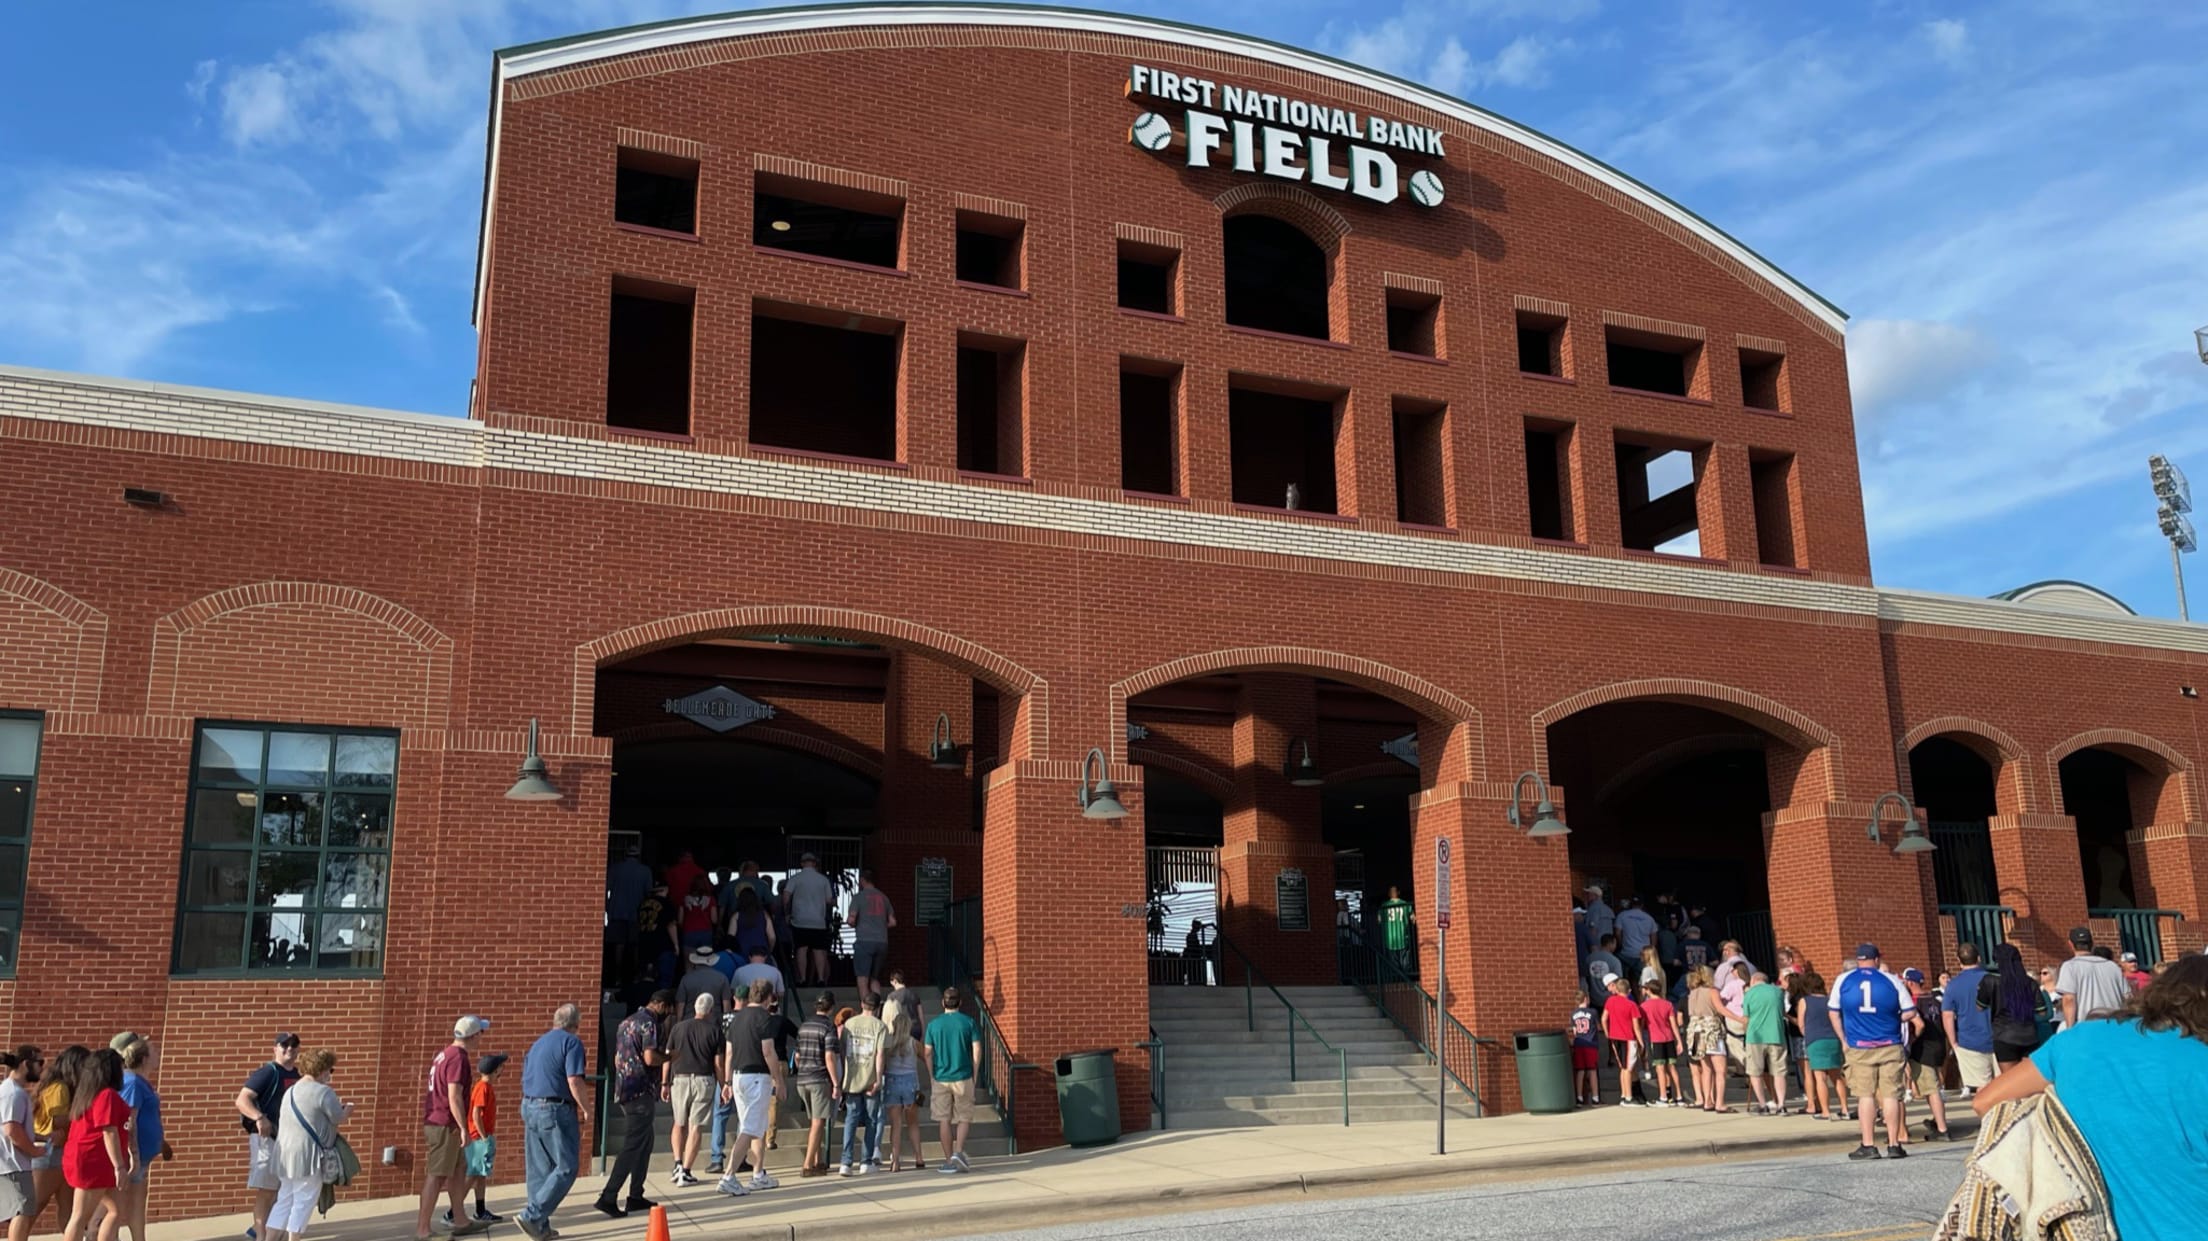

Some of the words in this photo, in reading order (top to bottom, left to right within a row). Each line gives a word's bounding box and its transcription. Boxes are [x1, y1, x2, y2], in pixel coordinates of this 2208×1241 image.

[1131, 64, 1216, 107] FIRST
[1222, 85, 1364, 140] NATIONAL
[1367, 115, 1445, 157] BANK
[1186, 109, 1399, 204] FIELD
[746, 704, 774, 719] GATE
[1387, 906, 1403, 921] 37
[1859, 981, 1876, 1013] 1
